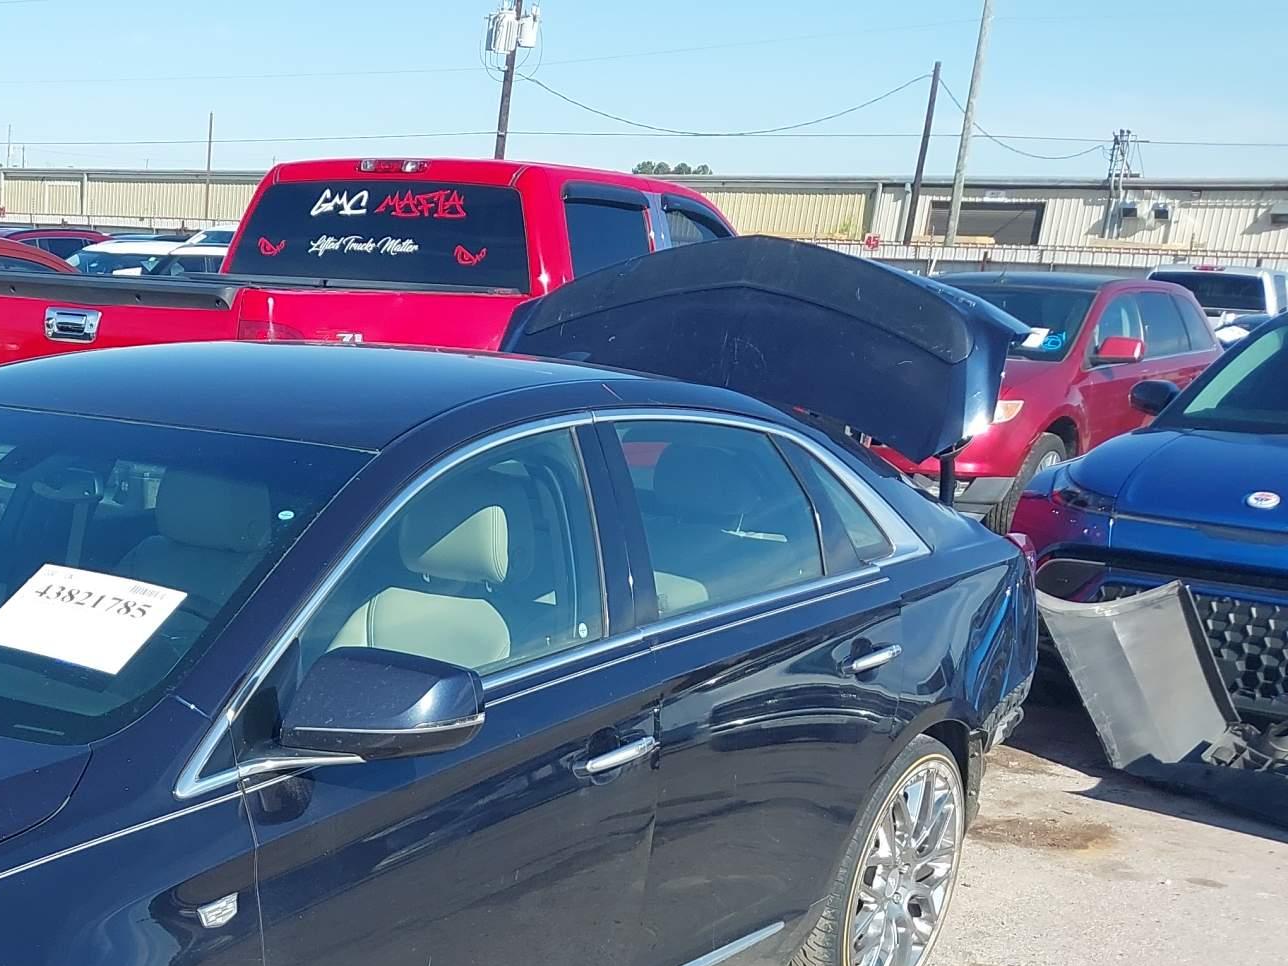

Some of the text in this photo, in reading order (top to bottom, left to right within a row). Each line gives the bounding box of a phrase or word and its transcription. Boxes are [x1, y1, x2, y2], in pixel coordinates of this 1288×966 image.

[310, 188, 467, 218] GMC MAFIA
[309, 235, 419, 256] Lifted Trucks Matter
[34, 584, 153, 618] 43821785
